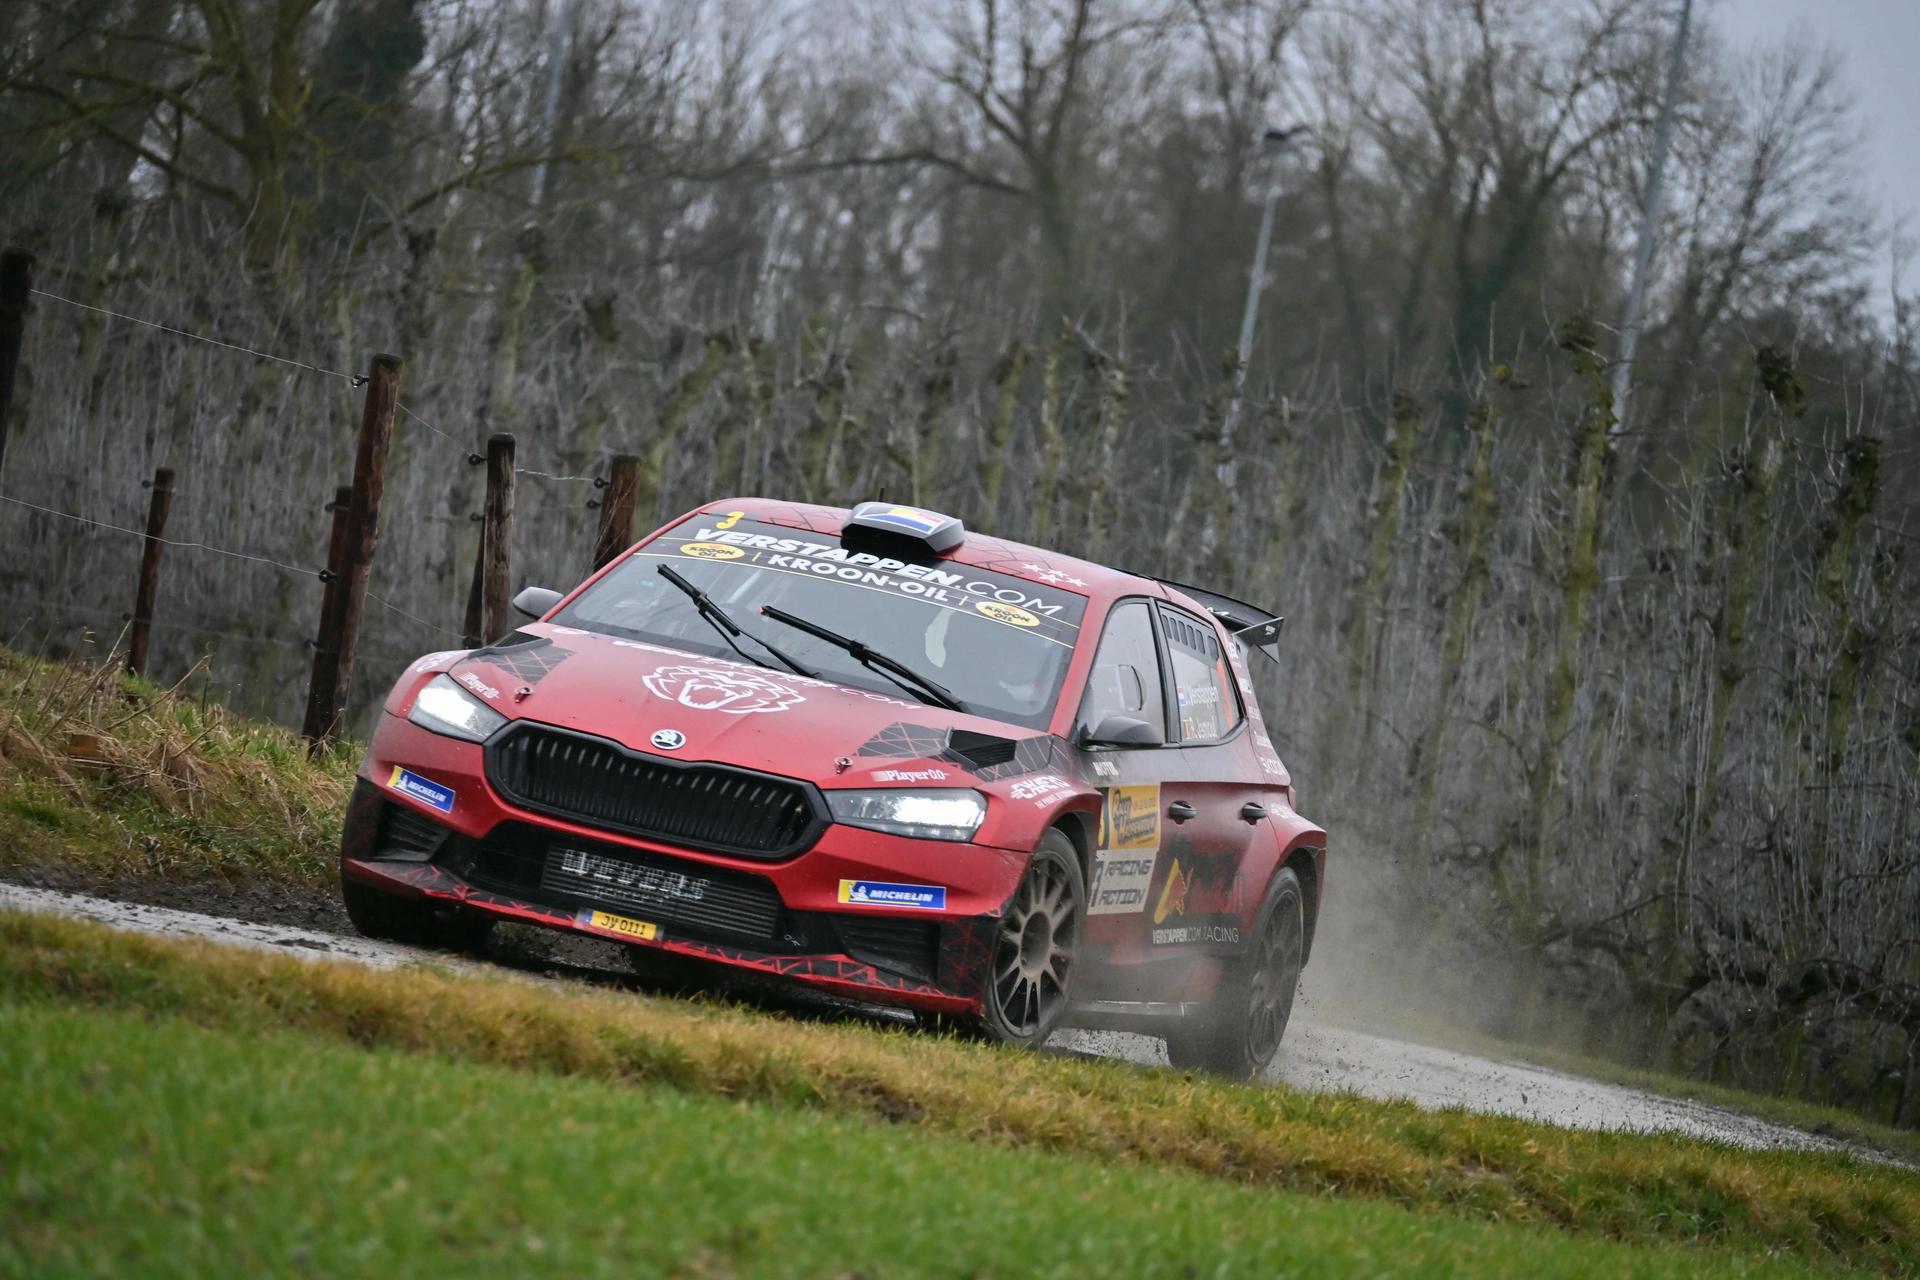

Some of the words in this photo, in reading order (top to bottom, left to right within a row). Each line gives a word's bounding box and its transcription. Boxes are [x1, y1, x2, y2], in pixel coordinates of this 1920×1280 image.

[717, 511, 744, 529] 3
[689, 546, 735, 556] KROON
[694, 529, 1063, 615] VERSTAPPEN.COM
[768, 554, 949, 602] KROON-OIL
[984, 605, 1031, 623] KROON
[993, 613, 1013, 622] OIL
[1104, 859, 1153, 877] RACING
[869, 889, 934, 902] MICHELIN
